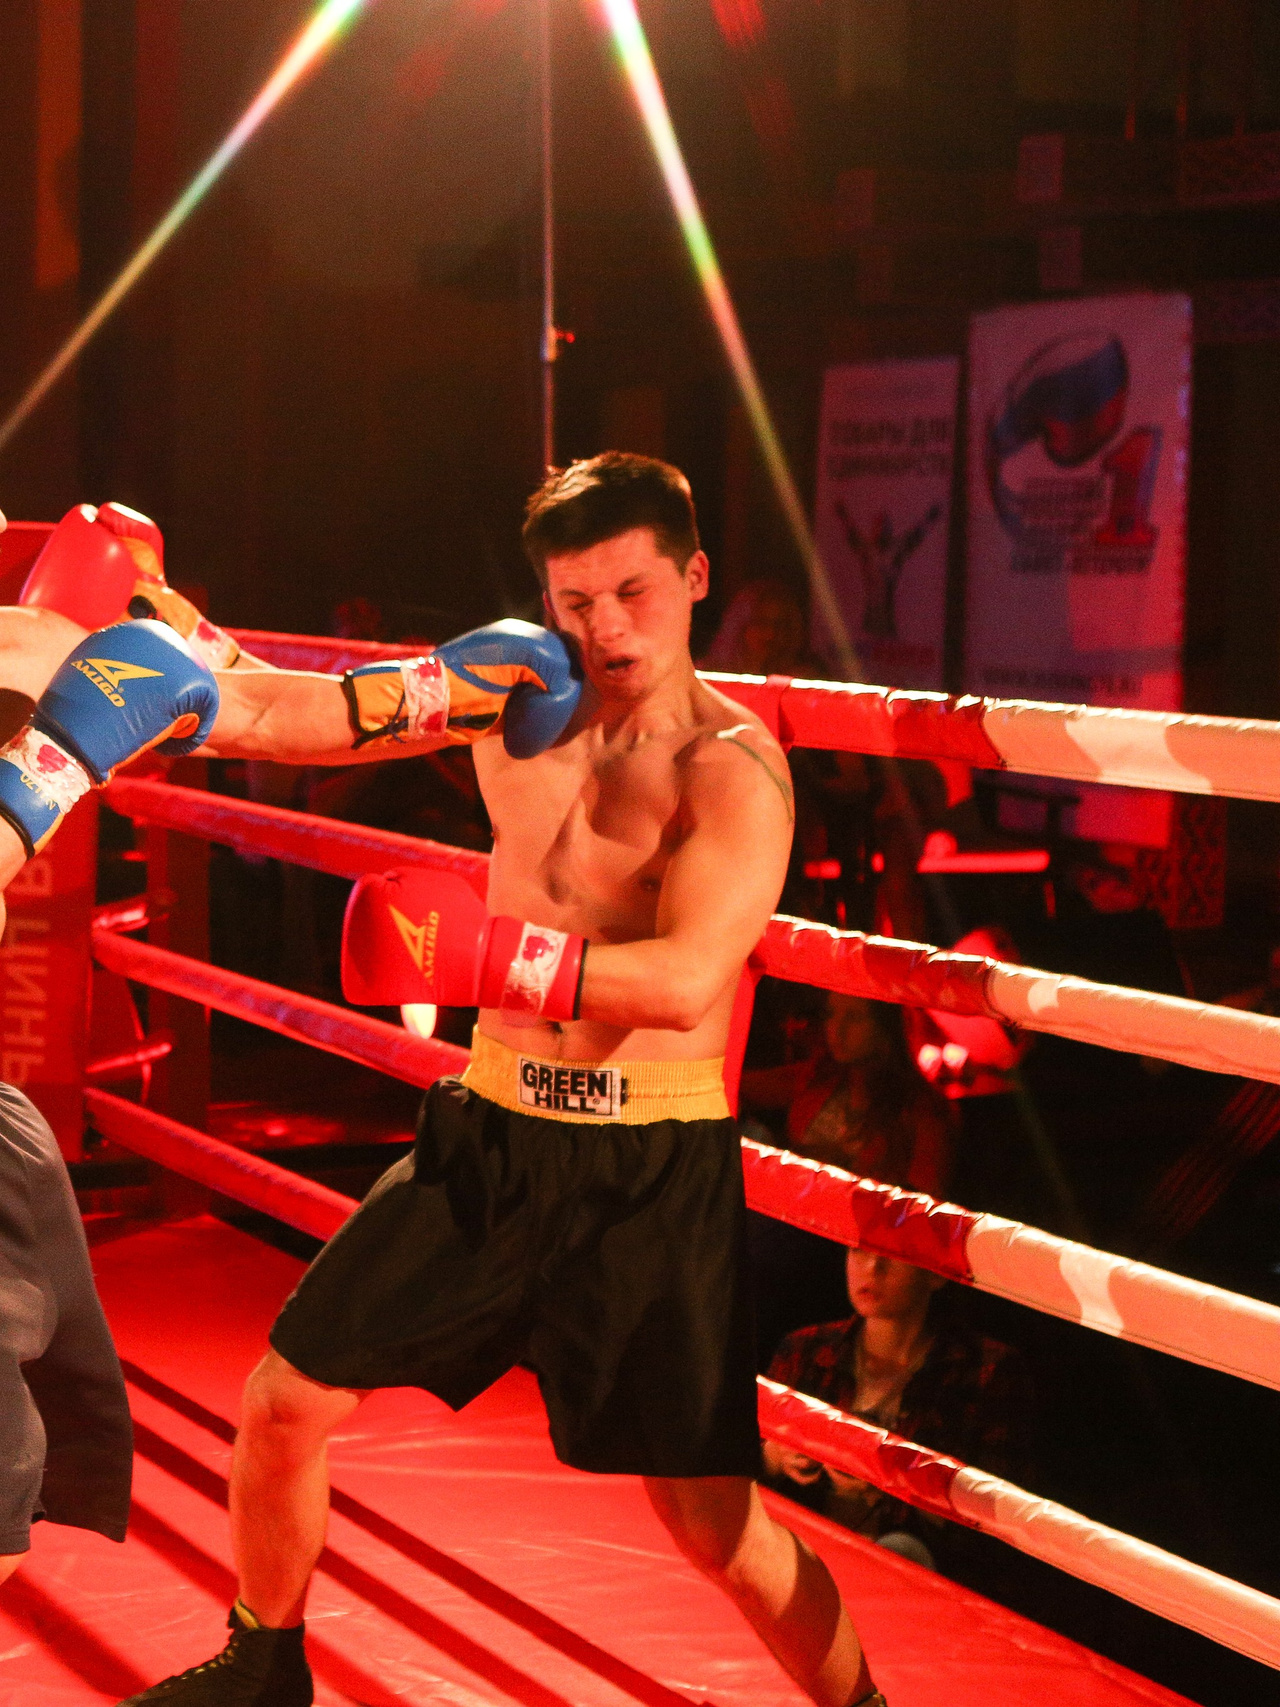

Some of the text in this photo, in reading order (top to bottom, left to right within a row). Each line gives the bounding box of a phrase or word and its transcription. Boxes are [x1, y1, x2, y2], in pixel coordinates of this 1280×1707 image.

[70, 659, 126, 707] AMIGO
[523, 1063, 607, 1098] GREEN
[535, 1091, 596, 1112] HILL
